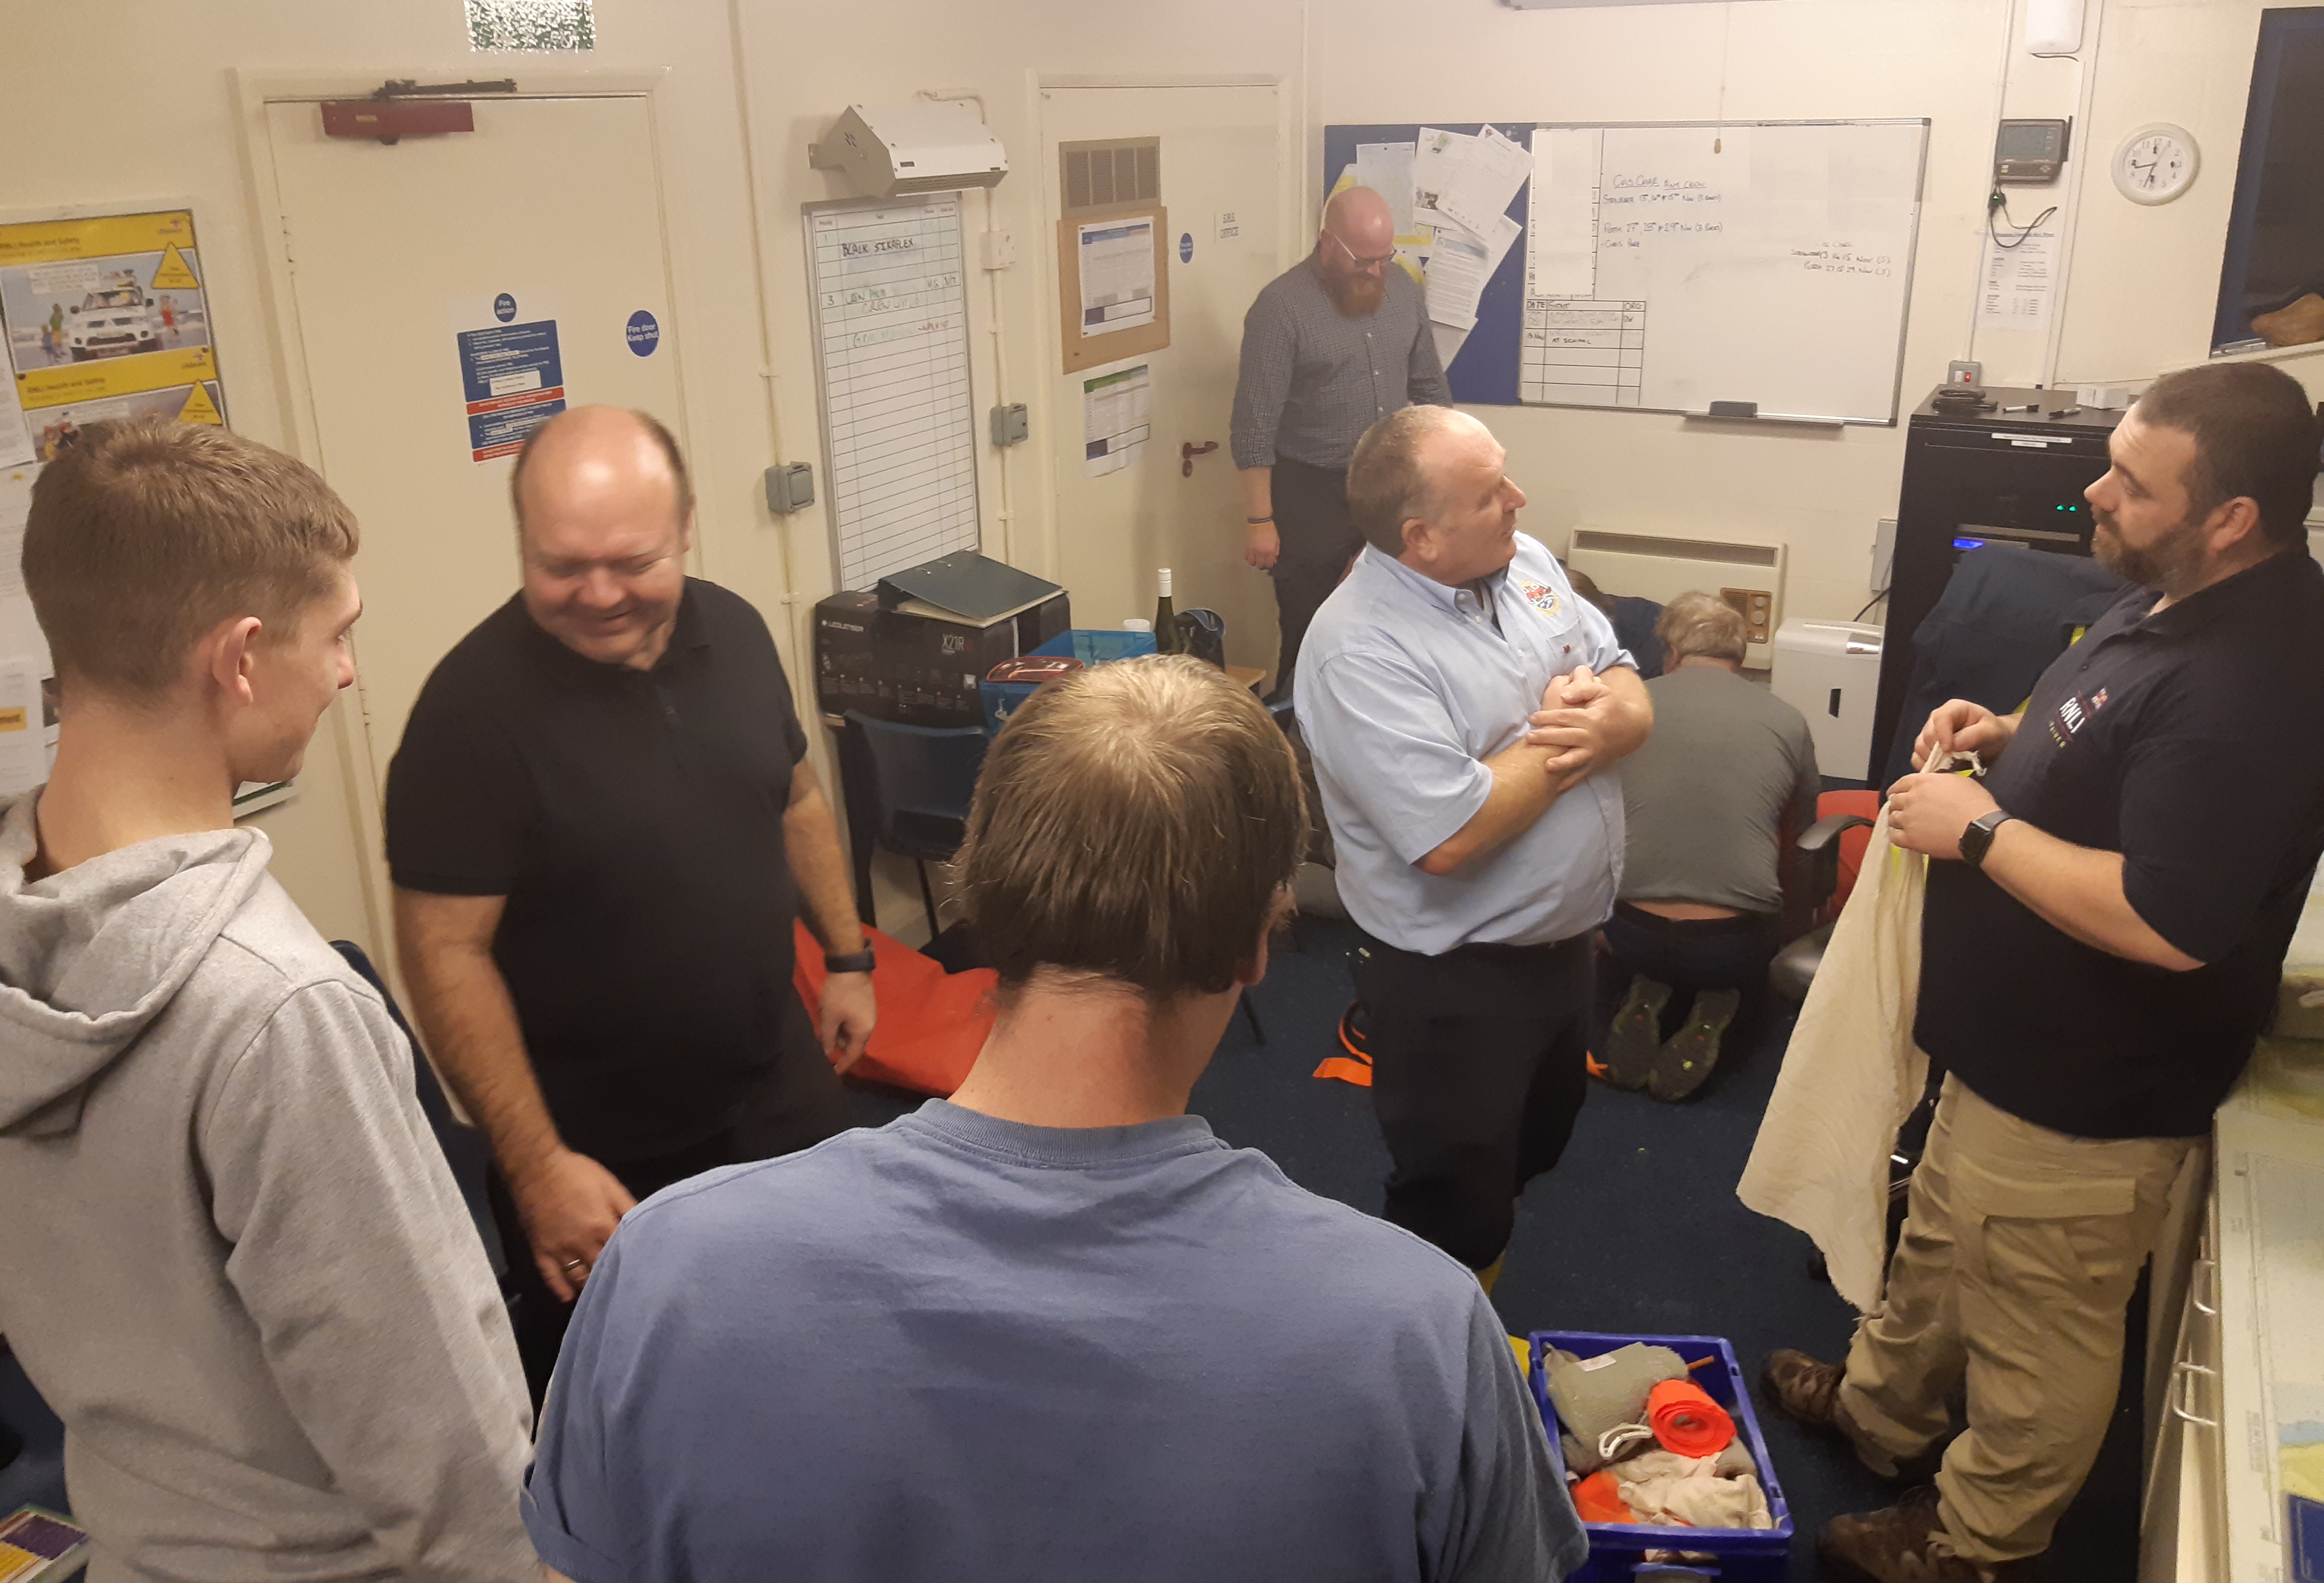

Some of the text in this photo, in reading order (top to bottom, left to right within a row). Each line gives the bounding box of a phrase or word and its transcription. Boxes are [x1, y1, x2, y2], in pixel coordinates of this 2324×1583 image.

[627, 324, 656, 334] Fire door
[627, 334, 644, 343] Keep
[2058, 697, 2086, 735] RNLI
